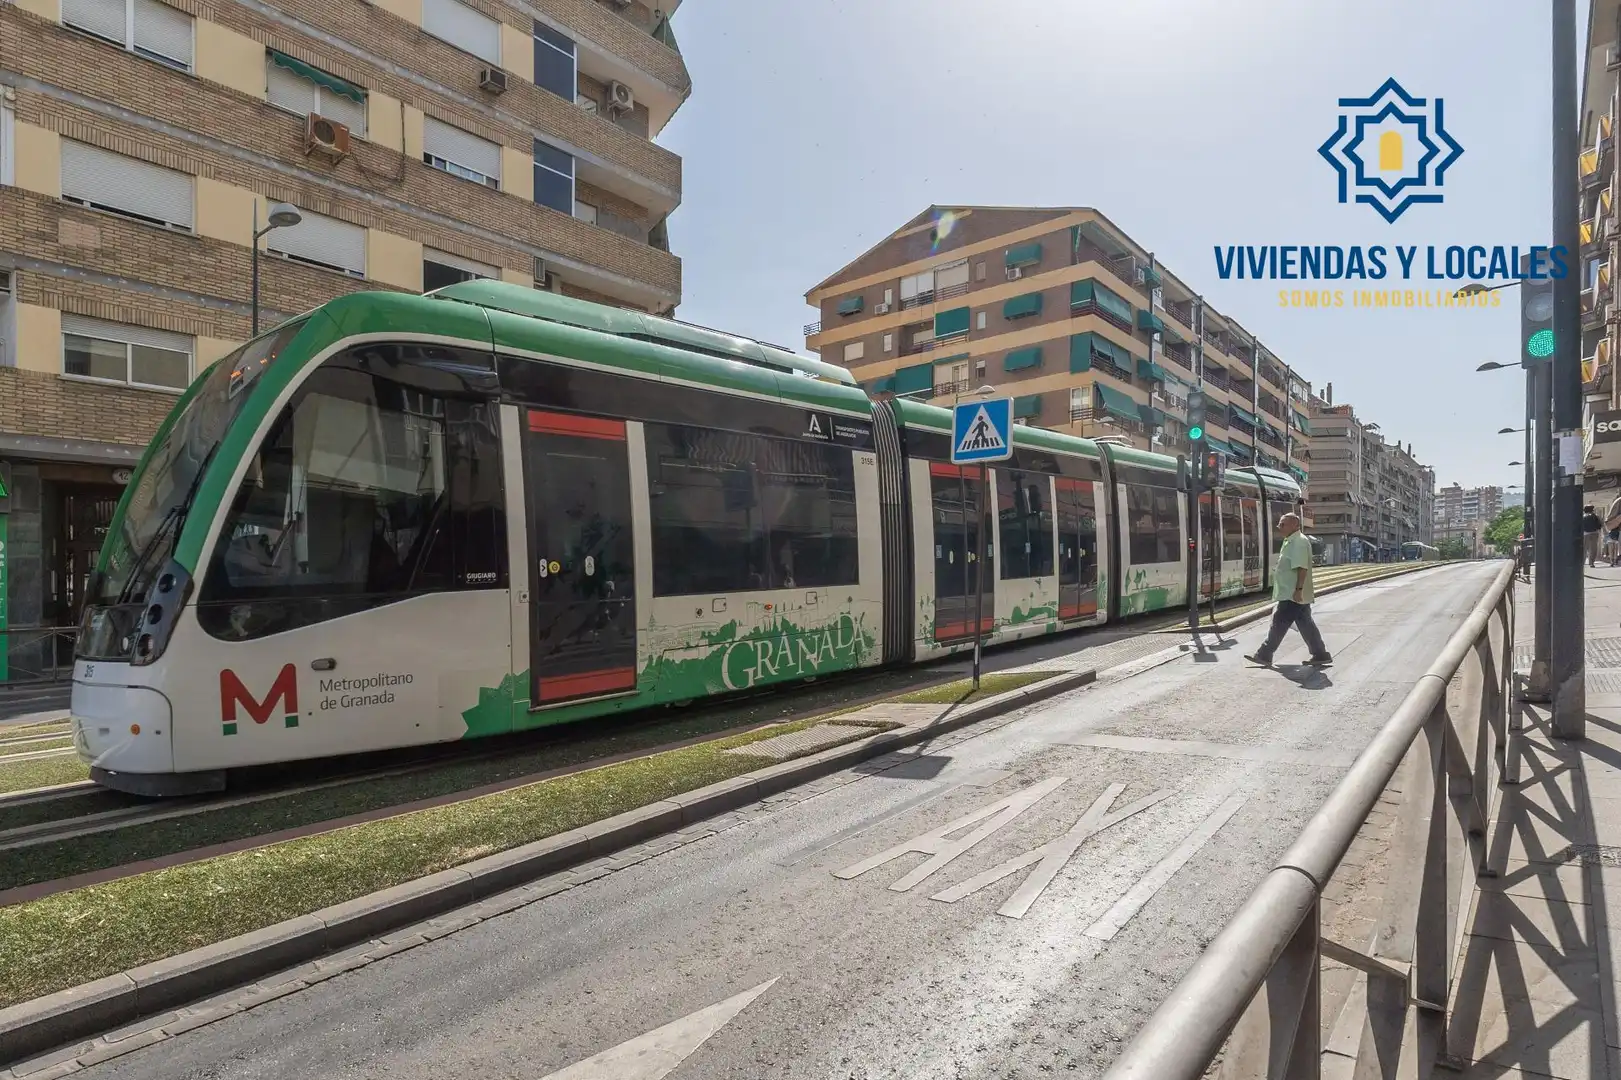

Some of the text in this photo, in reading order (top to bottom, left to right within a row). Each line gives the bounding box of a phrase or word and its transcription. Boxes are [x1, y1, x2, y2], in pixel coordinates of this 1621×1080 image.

[721, 612, 869, 691] GRANADA
[319, 672, 414, 693] Metropolitano
[320, 690, 395, 710] de Granada
